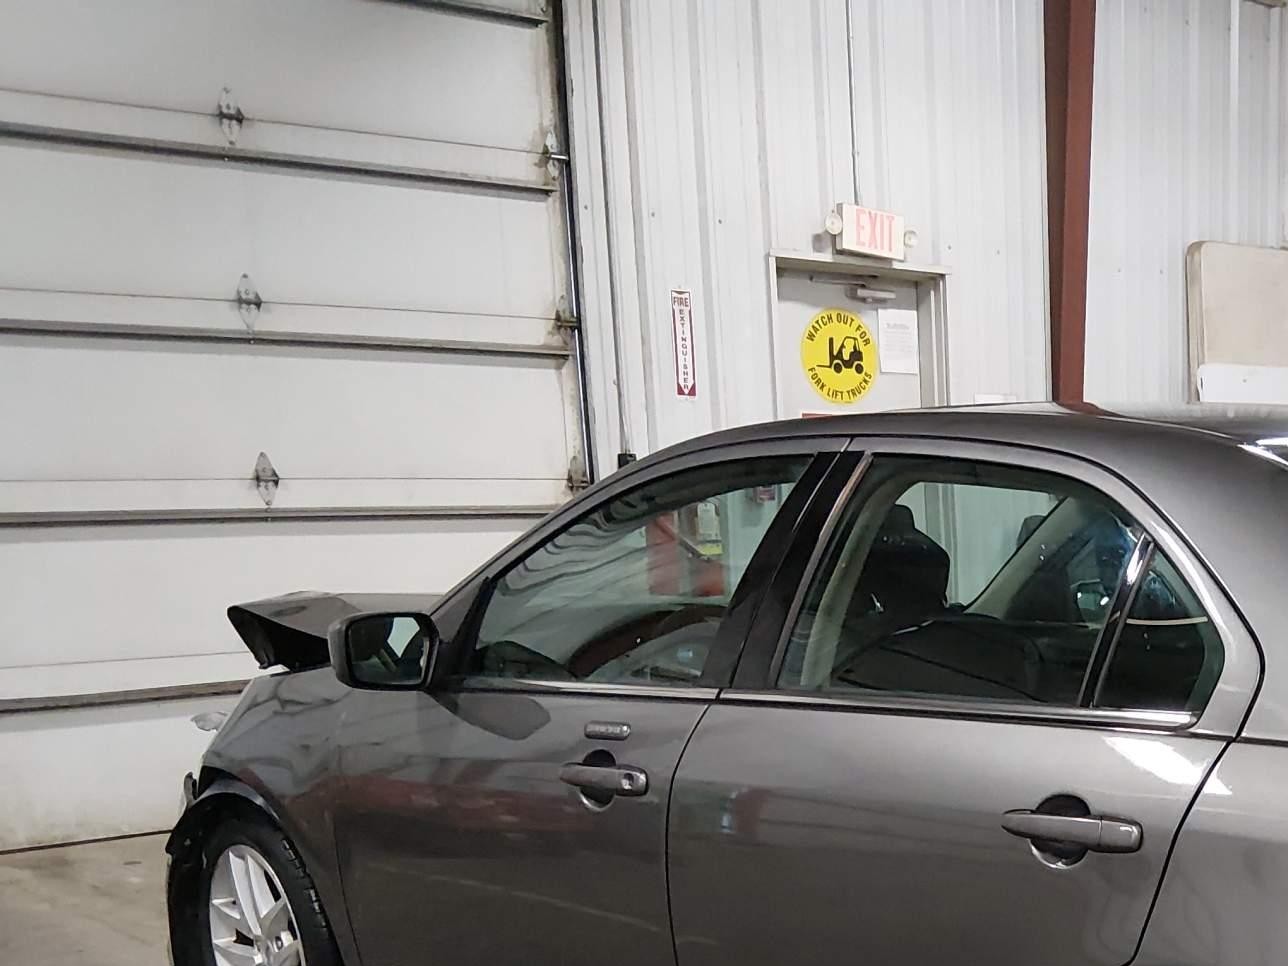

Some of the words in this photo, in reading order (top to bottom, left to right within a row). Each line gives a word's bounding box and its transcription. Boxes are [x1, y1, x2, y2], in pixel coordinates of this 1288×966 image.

[855, 208, 895, 252] EXIT
[673, 297, 689, 308] FIRE
[806, 313, 833, 342] WATCH
[836, 312, 855, 328] OUT
[855, 324, 871, 347] FOR
[679, 308, 689, 390] EXTINGUISHER
[807, 367, 827, 393] FORK
[826, 387, 844, 401] LIFT
[847, 371, 873, 400] TRUCKS
